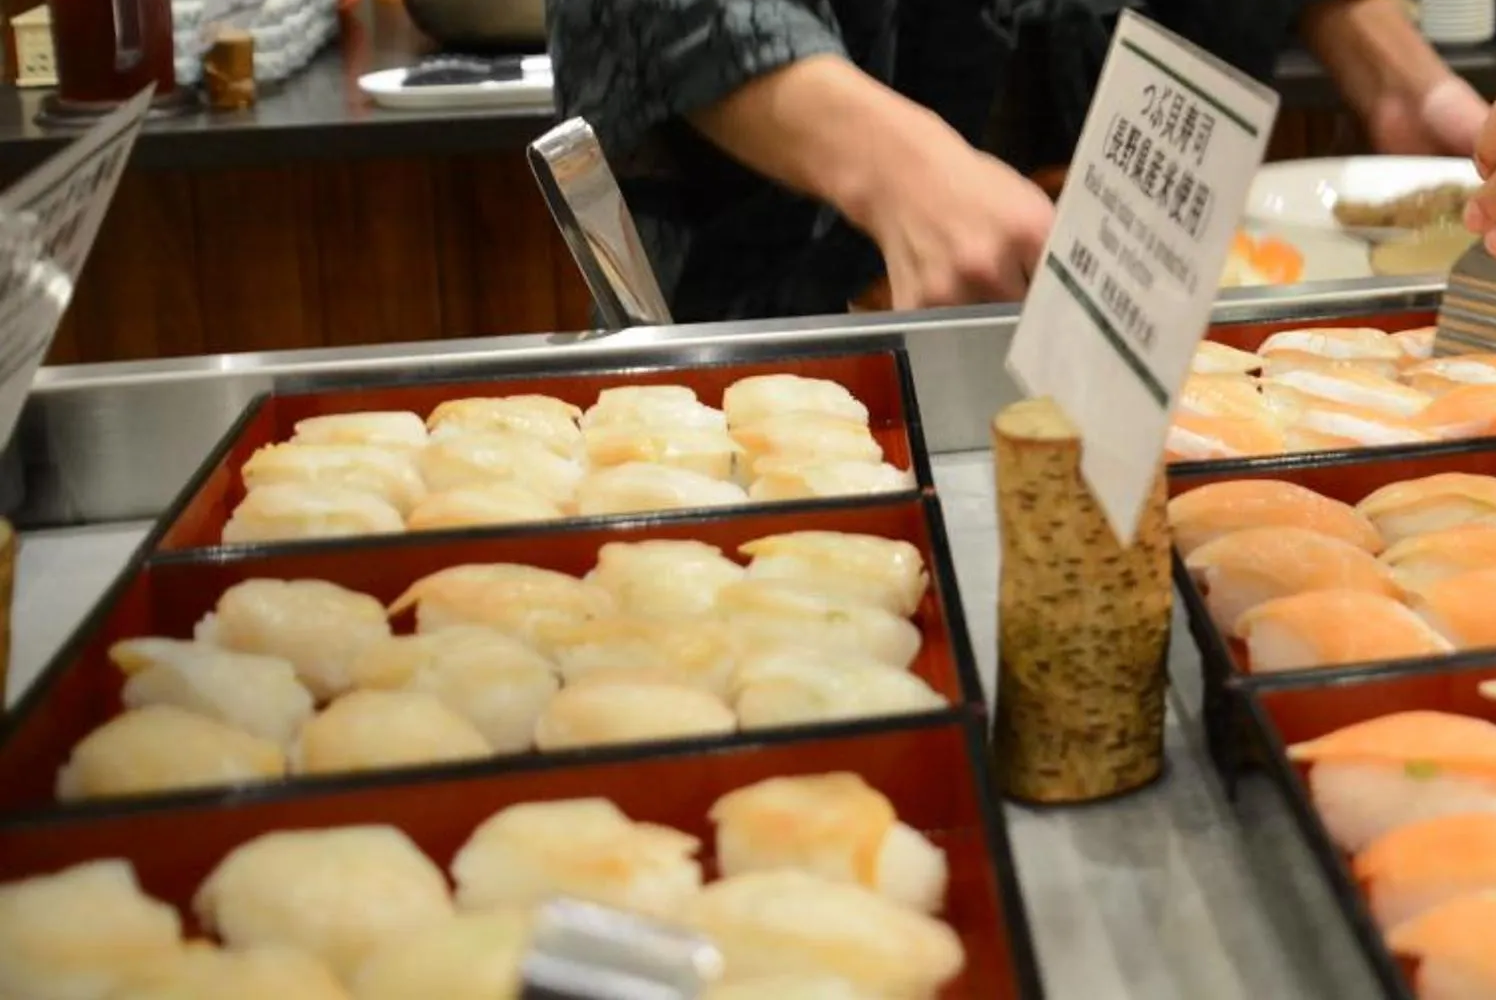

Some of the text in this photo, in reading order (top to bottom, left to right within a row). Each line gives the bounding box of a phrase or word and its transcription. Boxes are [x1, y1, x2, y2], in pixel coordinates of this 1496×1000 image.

[1141, 83, 1216, 166] つぶ貝寿司
